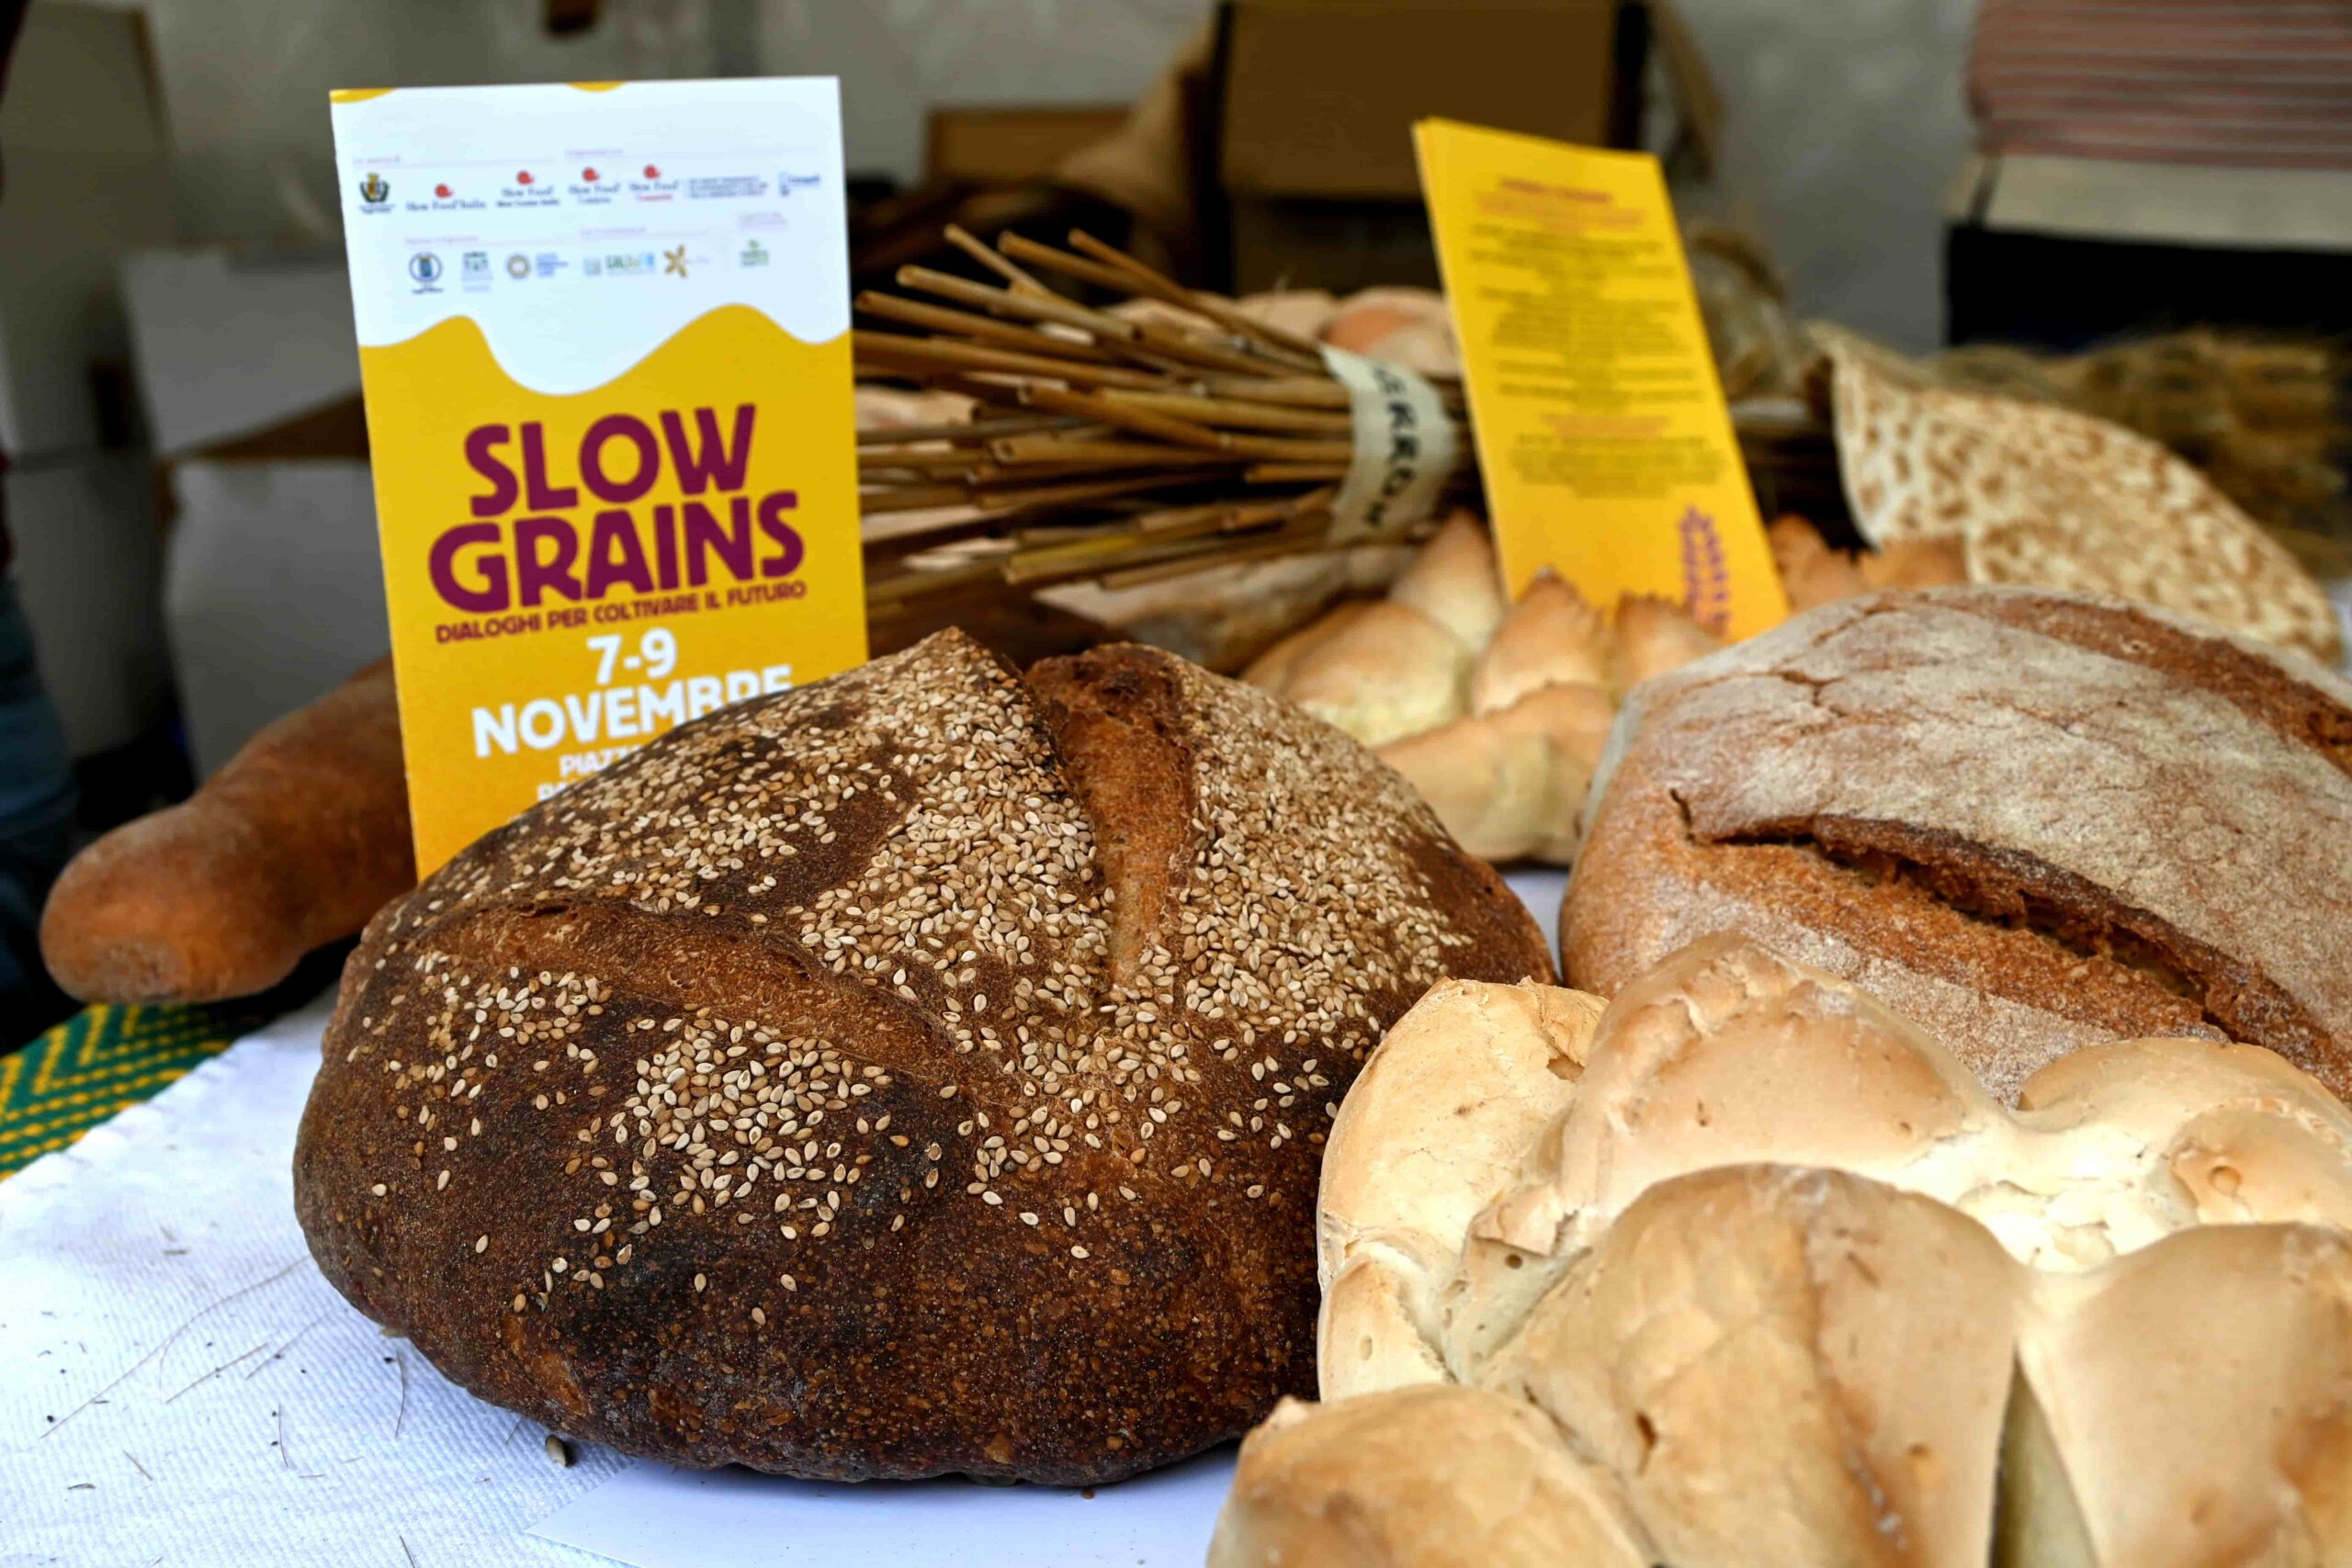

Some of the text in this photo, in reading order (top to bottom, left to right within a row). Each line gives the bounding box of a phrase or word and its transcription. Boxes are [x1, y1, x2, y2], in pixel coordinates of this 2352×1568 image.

[464, 403, 756, 518] SLOW
[427, 490, 805, 614] GRAINS
[435, 580, 808, 644] DIALOGHI PER COLTIVARE IL FUTURO
[586, 627, 677, 685] 7-9
